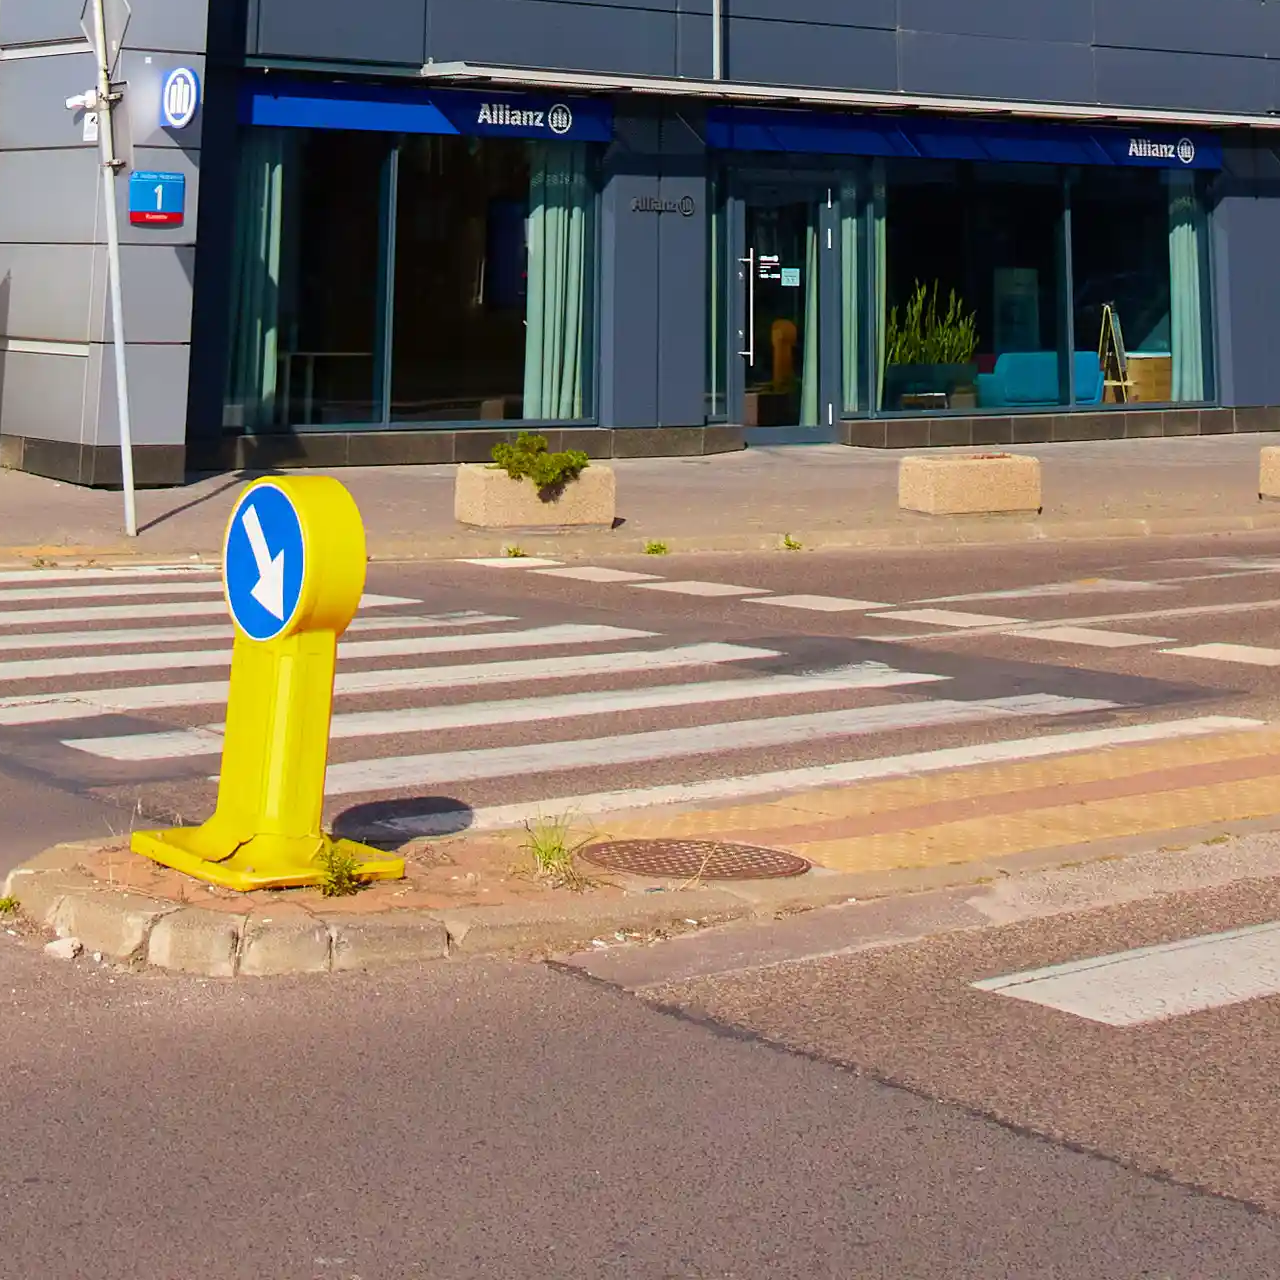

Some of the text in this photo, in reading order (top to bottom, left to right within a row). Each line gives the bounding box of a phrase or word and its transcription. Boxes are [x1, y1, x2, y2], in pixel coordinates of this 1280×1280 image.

[478, 103, 545, 127] Allianz
[1128, 139, 1176, 157] Allianz
[154, 183, 164, 211] 1
[631, 195, 677, 213] Allianz
